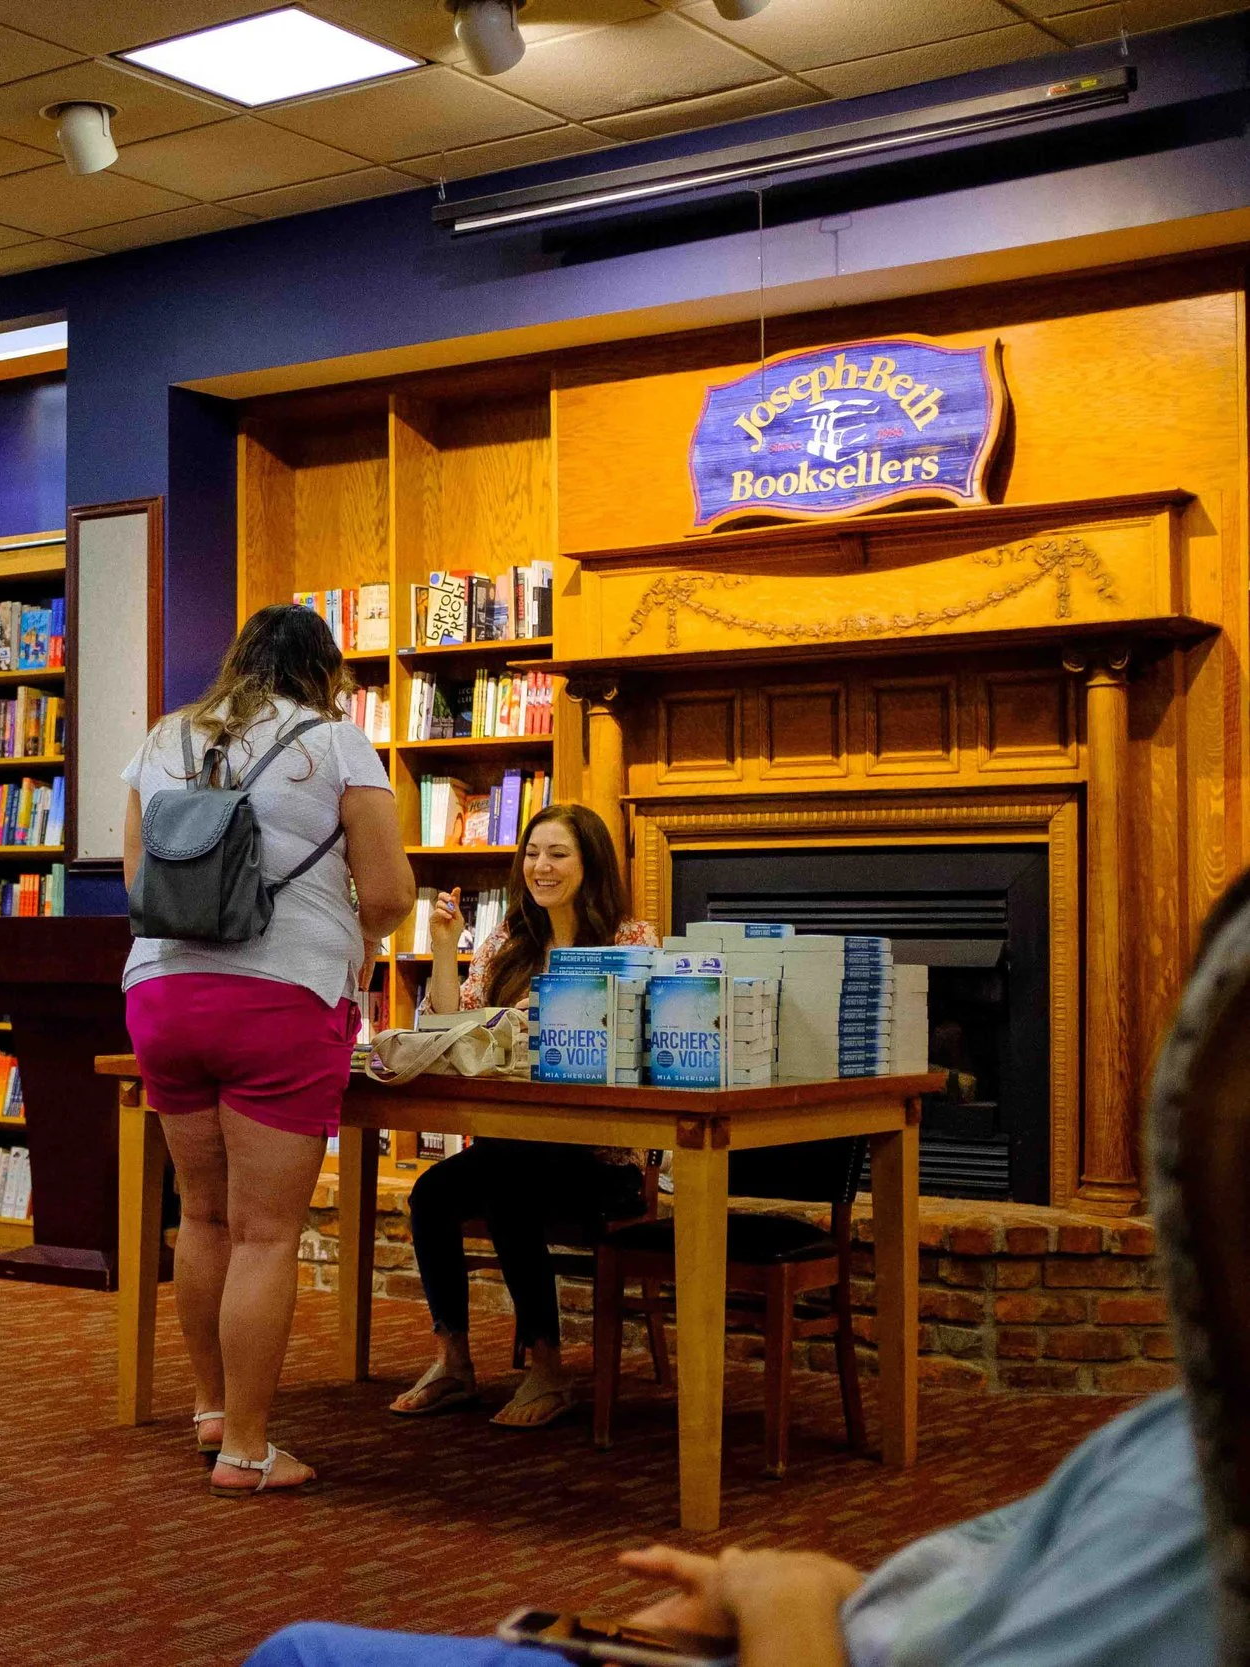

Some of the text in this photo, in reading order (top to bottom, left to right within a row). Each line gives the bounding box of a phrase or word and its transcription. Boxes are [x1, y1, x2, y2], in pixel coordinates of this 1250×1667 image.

[734, 353, 944, 452] Joseph-Beth
[729, 451, 939, 501] Booksellers
[540, 1029, 607, 1047] ARCHER'S
[651, 1031, 720, 1050] ARCHER'S
[566, 1048, 607, 1066] VOICE
[679, 1050, 720, 1068] VOICE
